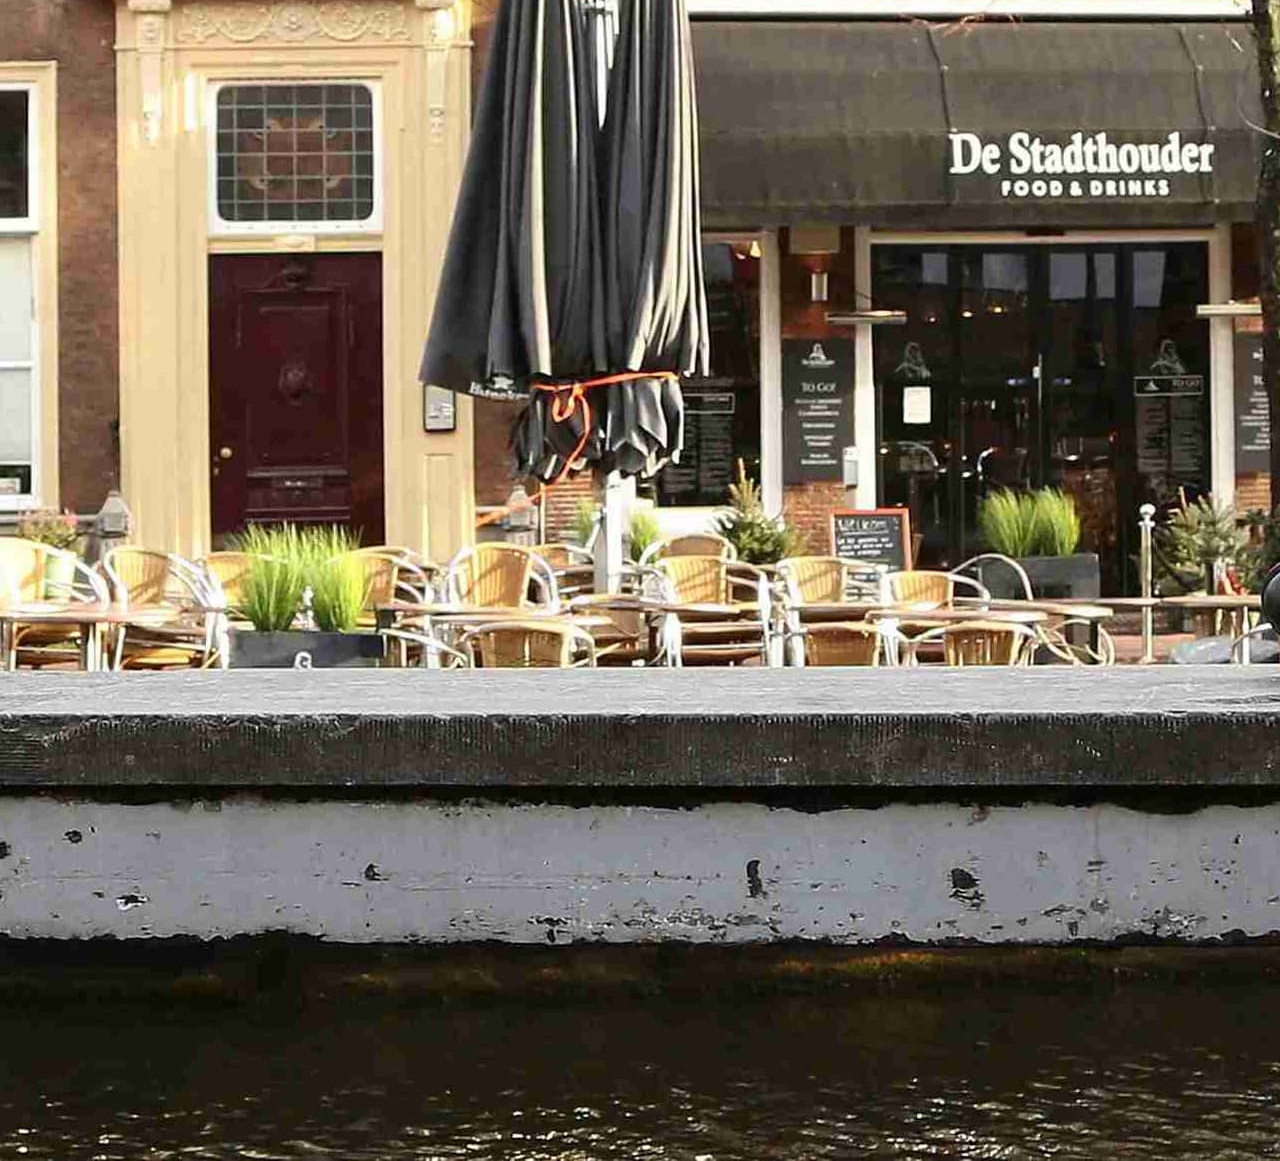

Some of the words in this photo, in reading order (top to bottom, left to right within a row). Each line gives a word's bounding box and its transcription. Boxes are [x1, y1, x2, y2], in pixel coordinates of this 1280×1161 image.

[949, 132, 1001, 174] De
[1009, 131, 1215, 174] Stadthouder
[1001, 180, 1064, 197] FOOD
[1070, 180, 1083, 197] &
[1090, 179, 1170, 197] DRINKS
